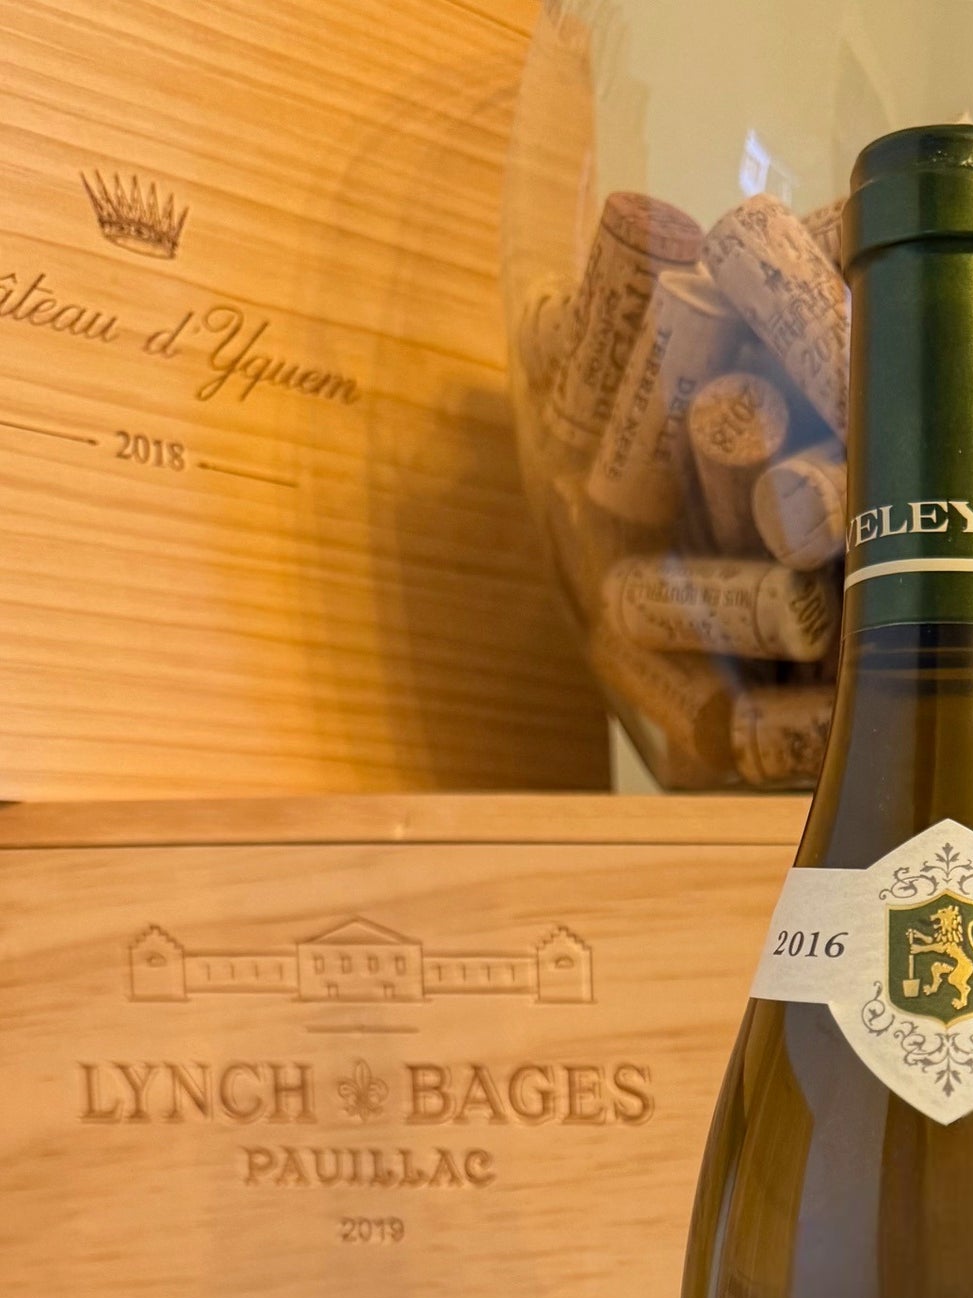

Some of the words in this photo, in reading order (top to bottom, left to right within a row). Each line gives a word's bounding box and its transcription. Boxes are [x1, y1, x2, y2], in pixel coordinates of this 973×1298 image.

[114, 430, 186, 472] 2018
[773, 930, 849, 958] 2016
[76, 1061, 318, 1124] LYNCH
[405, 1062, 654, 1125] BAGES
[241, 1145, 496, 1189] PAUILLAC
[340, 1215, 405, 1242] 2019
